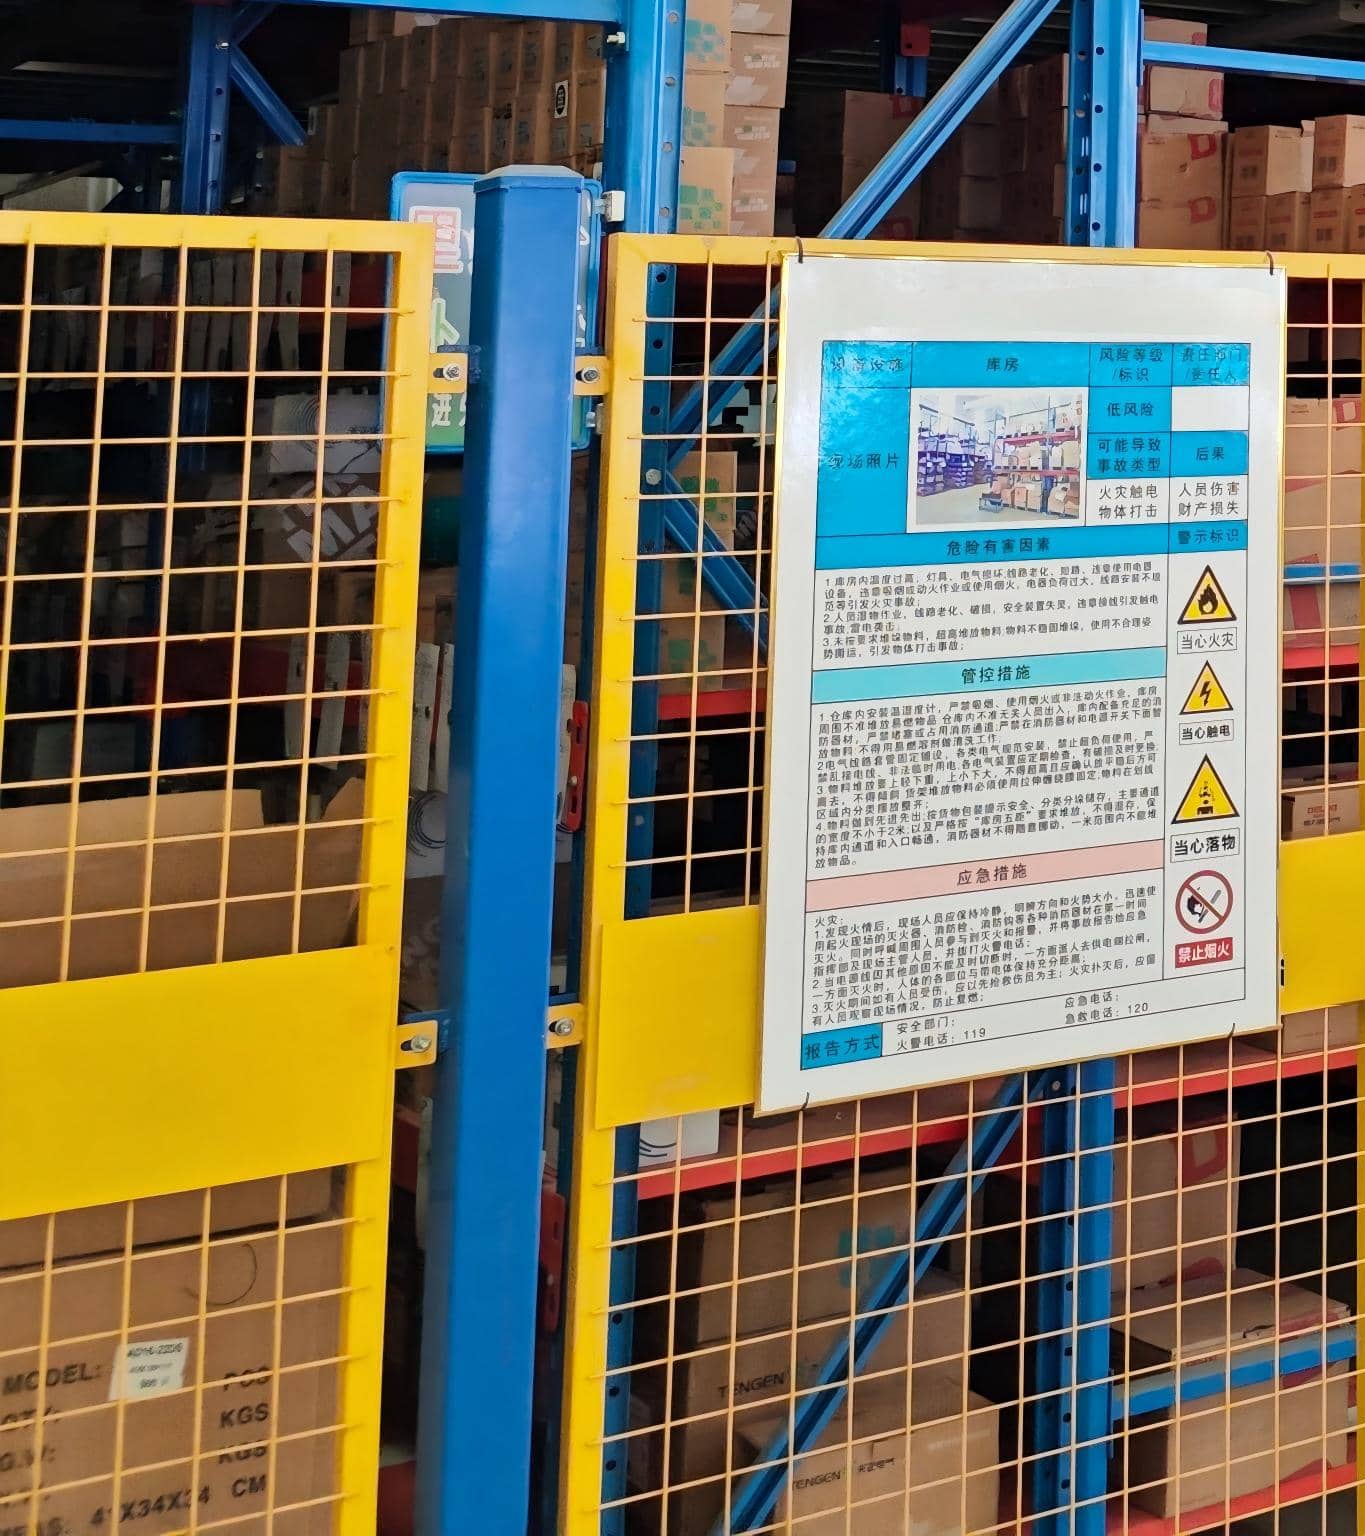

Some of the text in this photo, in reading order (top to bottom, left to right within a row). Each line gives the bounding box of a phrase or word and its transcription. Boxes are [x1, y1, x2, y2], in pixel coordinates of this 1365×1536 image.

[985, 357, 1019, 373] 库房
[1105, 401, 1154, 419] 低风险
[1097, 437, 1161, 454] 可能导致
[1194, 445, 1225, 463] 后果
[1096, 456, 1161, 472] 事故类型
[1097, 483, 1158, 501] 火灾触电
[1178, 480, 1240, 498] 人员伤害
[1097, 502, 1158, 520] 物体打击
[1177, 499, 1239, 517] 财产损失
[1176, 526, 1239, 546] 警示标识
[946, 536, 1050, 557] 危险有害因素
[1180, 630, 1234, 651] 当心火灾
[960, 662, 1031, 687] 管控措施
[1181, 722, 1231, 742] 当心触电
[1173, 832, 1237, 858] 当心落物
[956, 860, 1028, 888] 应急措施
[1177, 940, 1231, 965] 禁止烟火
[1127, 1001, 1148, 1014] 120
[963, 1027, 986, 1040] 119
[803, 1034, 880, 1063] 报告方式
[220, 1402, 269, 1429] KGS
[231, 1474, 266, 1499] CM
